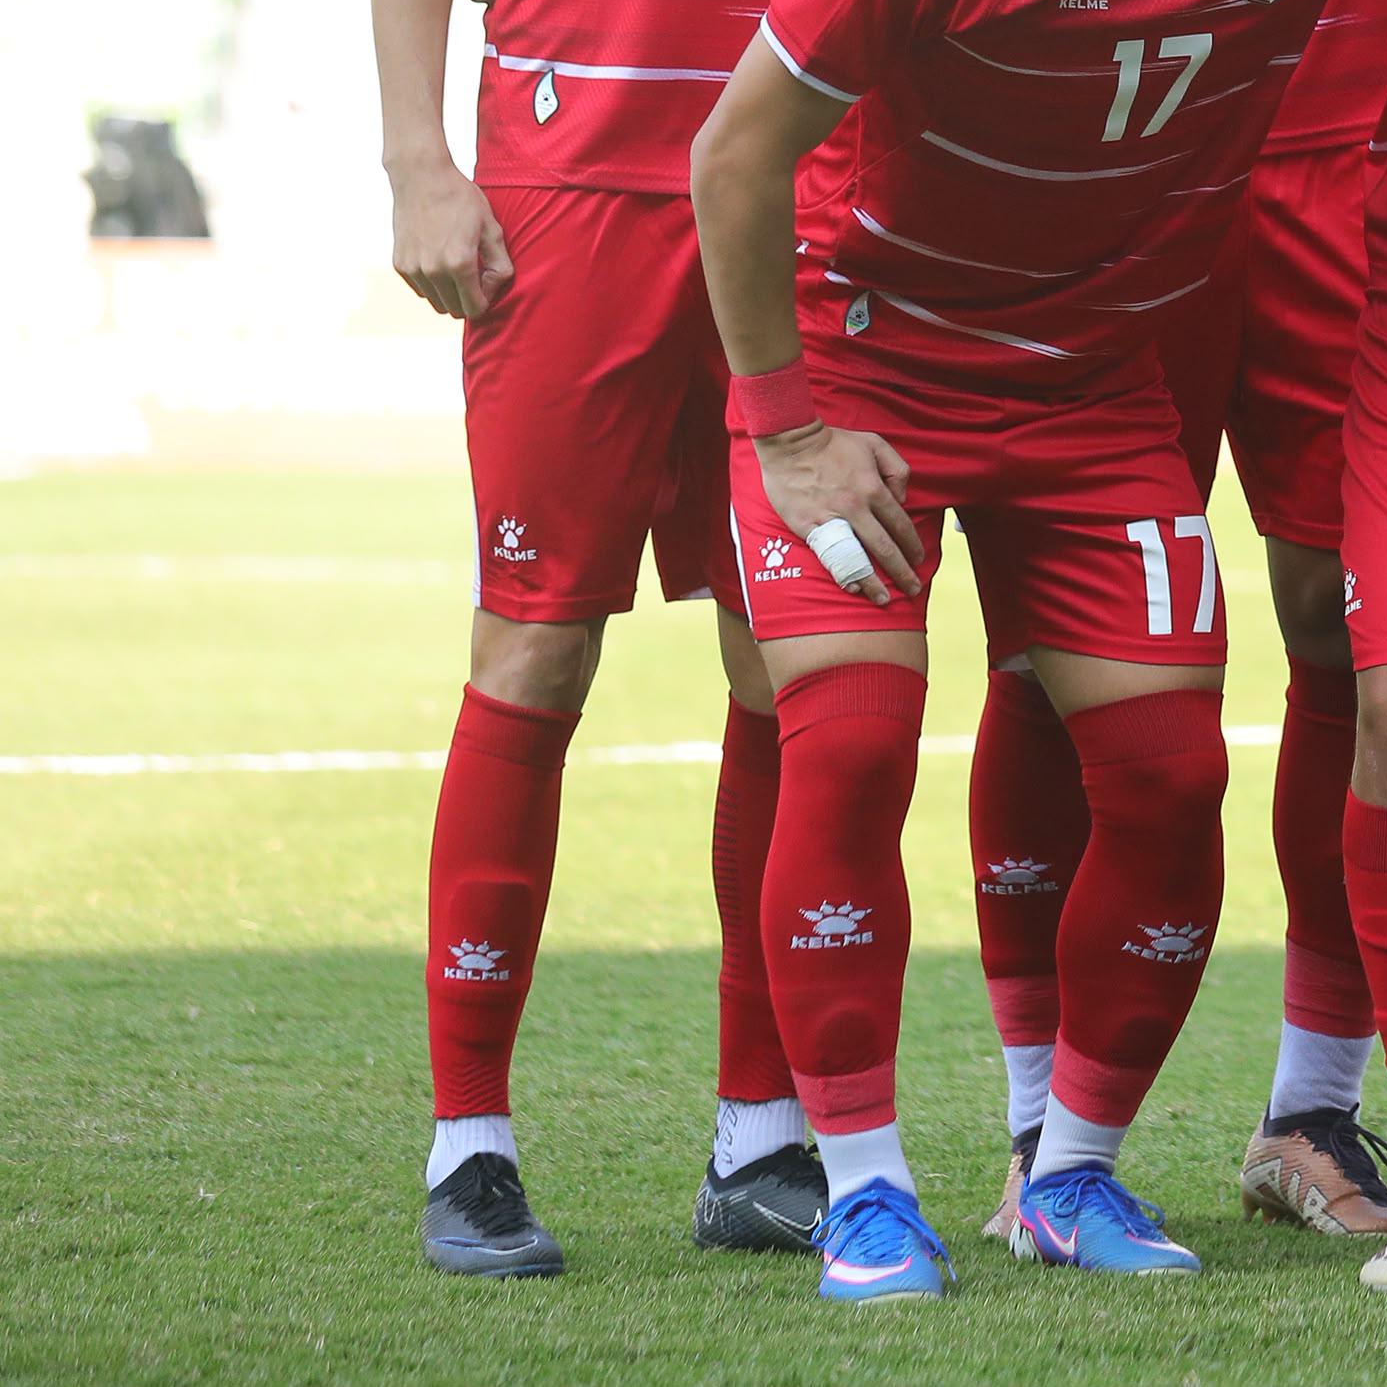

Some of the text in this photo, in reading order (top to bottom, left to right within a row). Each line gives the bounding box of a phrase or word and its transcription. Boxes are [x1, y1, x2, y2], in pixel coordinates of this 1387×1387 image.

[1102, 33, 1213, 143] 17
[755, 567, 802, 583] KELME
[1125, 515, 1218, 636] 17
[982, 882, 1057, 895] KELME
[790, 930, 873, 949] KELME
[444, 966, 510, 981] KELME
